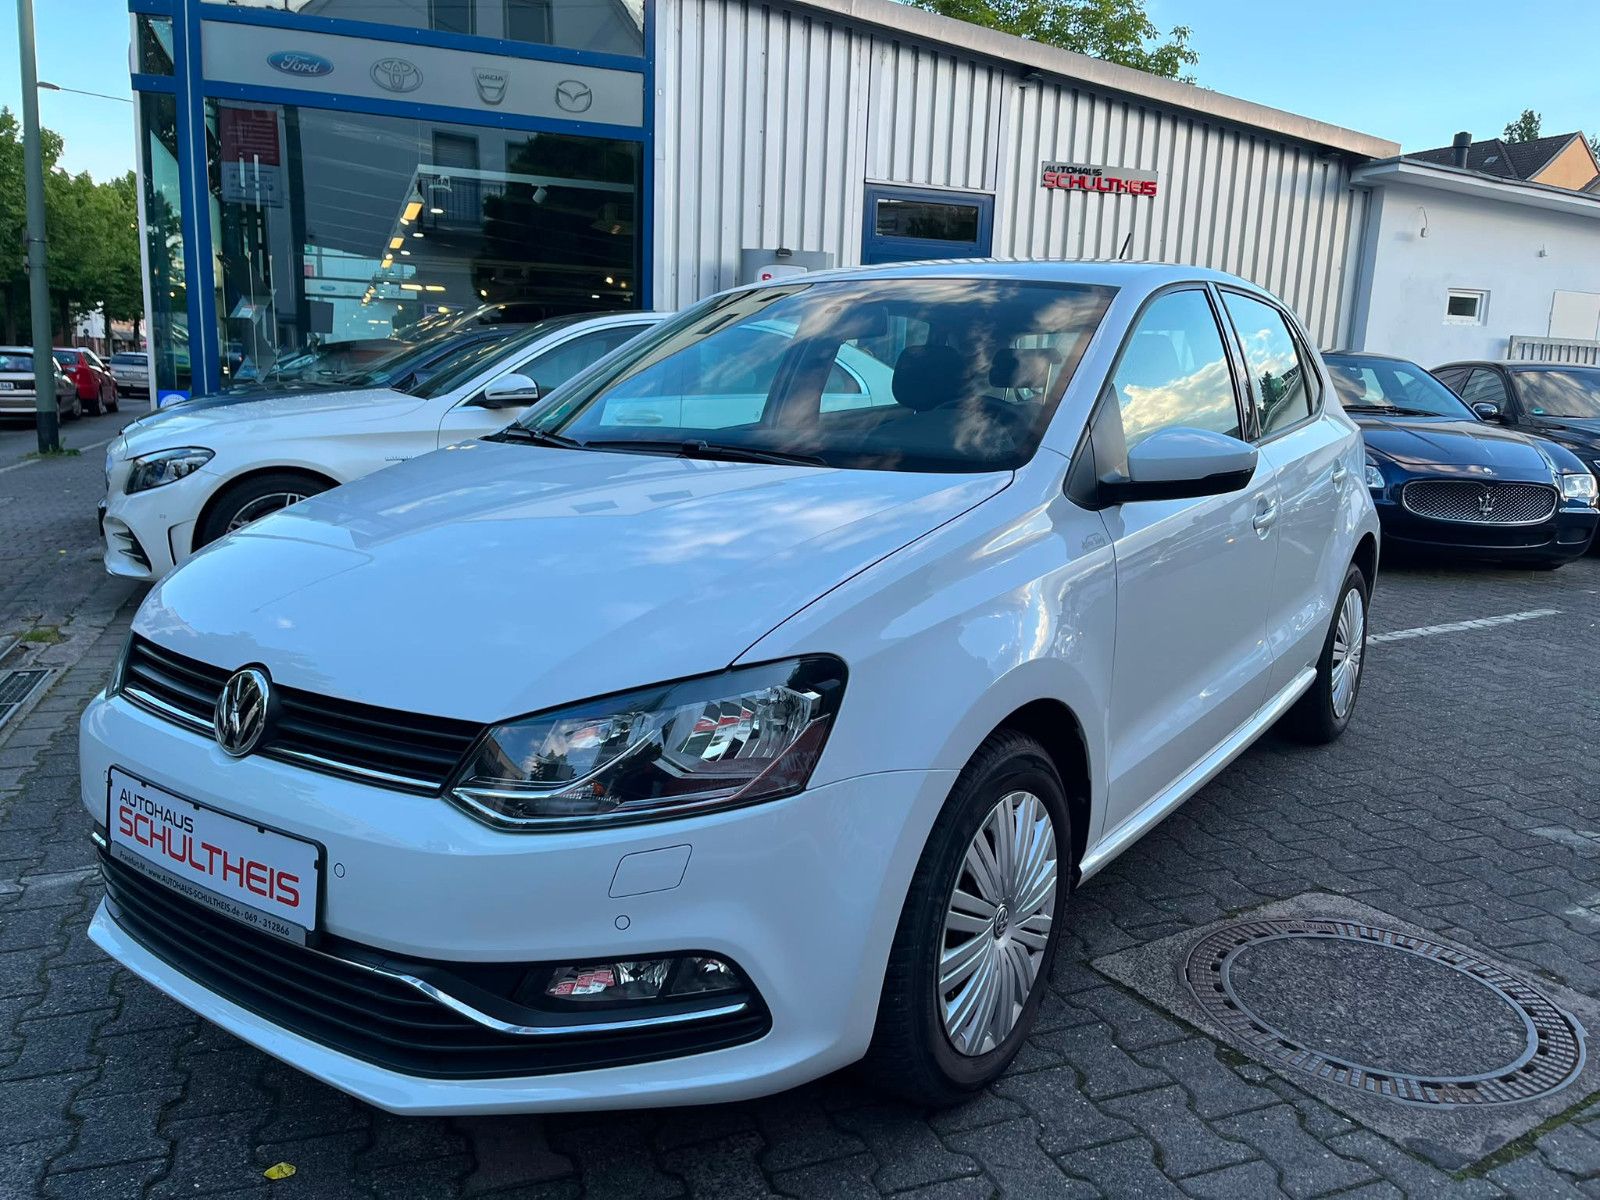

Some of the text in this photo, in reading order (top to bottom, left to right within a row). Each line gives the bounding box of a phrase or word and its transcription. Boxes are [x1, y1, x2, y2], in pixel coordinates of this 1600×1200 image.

[281, 55, 320, 73] Ford
[1043, 165, 1103, 176] AUTOHAUS
[1043, 172, 1158, 197] SCHULTHEIS
[119, 788, 194, 834] AUTOHAUS
[119, 804, 300, 908] SCHULTHEIS
[244, 911, 258, 923] 069
[263, 918, 290, 936] 312866
